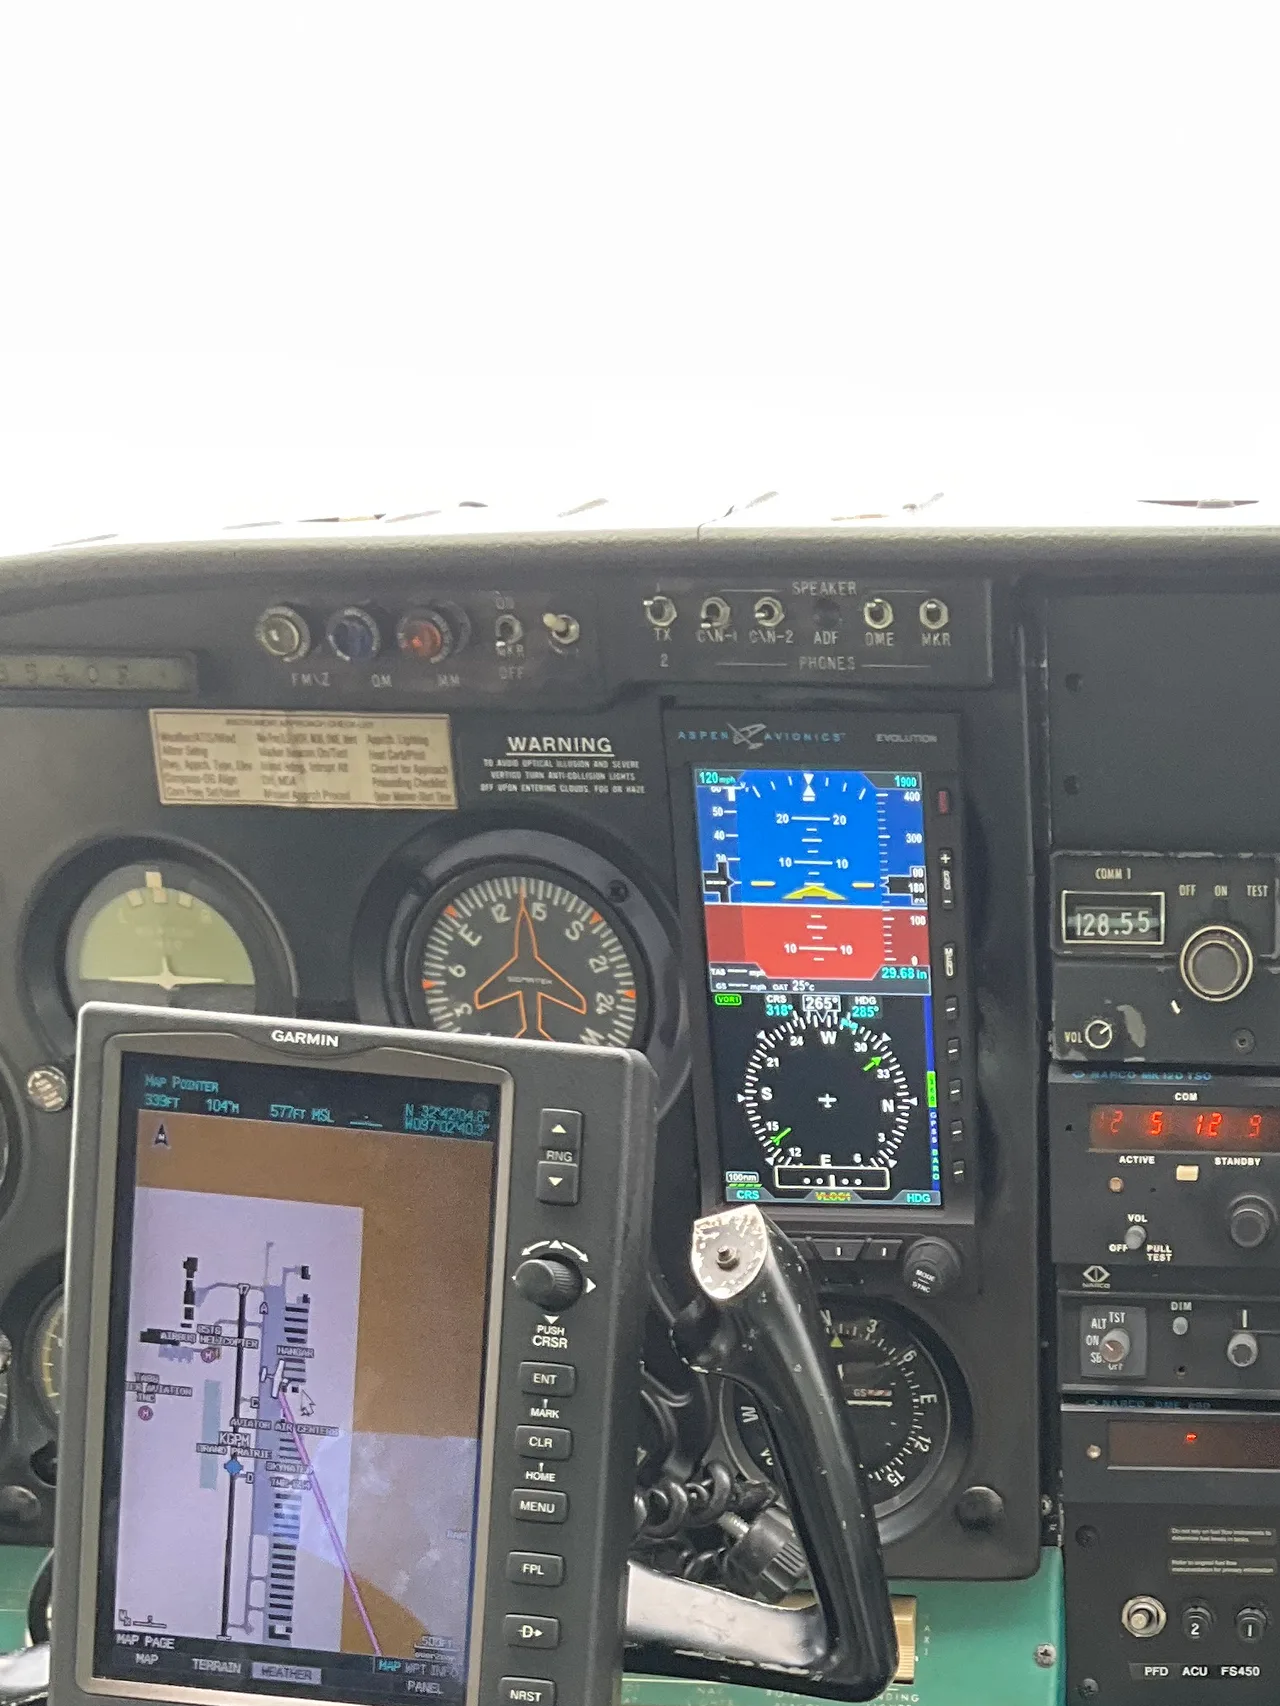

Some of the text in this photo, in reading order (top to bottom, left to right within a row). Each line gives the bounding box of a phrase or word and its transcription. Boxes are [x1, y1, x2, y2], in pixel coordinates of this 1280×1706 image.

[792, 582, 857, 595] SPEAKER
[814, 632, 951, 646] ADF MKR
[800, 657, 856, 670] PHONES
[678, 732, 842, 742] ASPEN AVIONICS
[876, 734, 937, 743] EVOLUTION
[507, 736, 613, 752] WARNING
[522, 760, 553, 768] OPTICAL
[612, 761, 640, 769] SEVERE
[490, 771, 521, 779] VERTIGO
[525, 771, 545, 779] TURN
[609, 772, 636, 780] LIGHTS
[700, 772, 718, 784] 120
[895, 775, 917, 787] 1900
[521, 784, 557, 792] ENTERING
[626, 785, 645, 793] HAZE
[776, 814, 846, 825] 20 20
[906, 834, 922, 843] 300
[779, 858, 849, 869] 10 10
[1095, 868, 1122, 879] COMM
[1179, 885, 1268, 896] OFF ON TEST
[1076, 910, 1150, 936] 128.55
[881, 968, 914, 979] 29.68
[272, 1030, 339, 1048] GARMIN
[1065, 1032, 1082, 1043] VOL
[1175, 1093, 1197, 1101] COM
[546, 1150, 573, 1162] RNG
[1119, 1156, 1155, 1164] ACTIVE
[1215, 1157, 1260, 1166] STANDBY
[737, 1190, 759, 1199] CRS
[906, 1193, 931, 1202] HDG
[1128, 1214, 1147, 1222] VOL
[1147, 1245, 1172, 1253] PULL
[1147, 1253, 1172, 1261] TEST
[1171, 1302, 1192, 1310] DIM
[1109, 1311, 1125, 1323] TST
[1091, 1318, 1106, 1329] ALT
[537, 1325, 565, 1336] PUSH
[532, 1335, 568, 1349] CRSR
[1086, 1335, 1099, 1346] ON
[533, 1373, 557, 1385] ENT
[530, 1407, 560, 1419] MARK
[219, 1432, 250, 1447] KGPM
[529, 1436, 553, 1450] CLR
[525, 1470, 556, 1483] HOME
[520, 1500, 555, 1515] MENU
[522, 1562, 545, 1576] FPL
[116, 1633, 175, 1650] MAP PAGE
[135, 1653, 159, 1665] MAP
[192, 1658, 242, 1674] TERRAIN
[1145, 1666, 1260, 1677] PFD ACU FS450
[261, 1667, 312, 1681] WEATHER
[407, 1680, 444, 1695] PANEL
[510, 1689, 542, 1703] NRST
